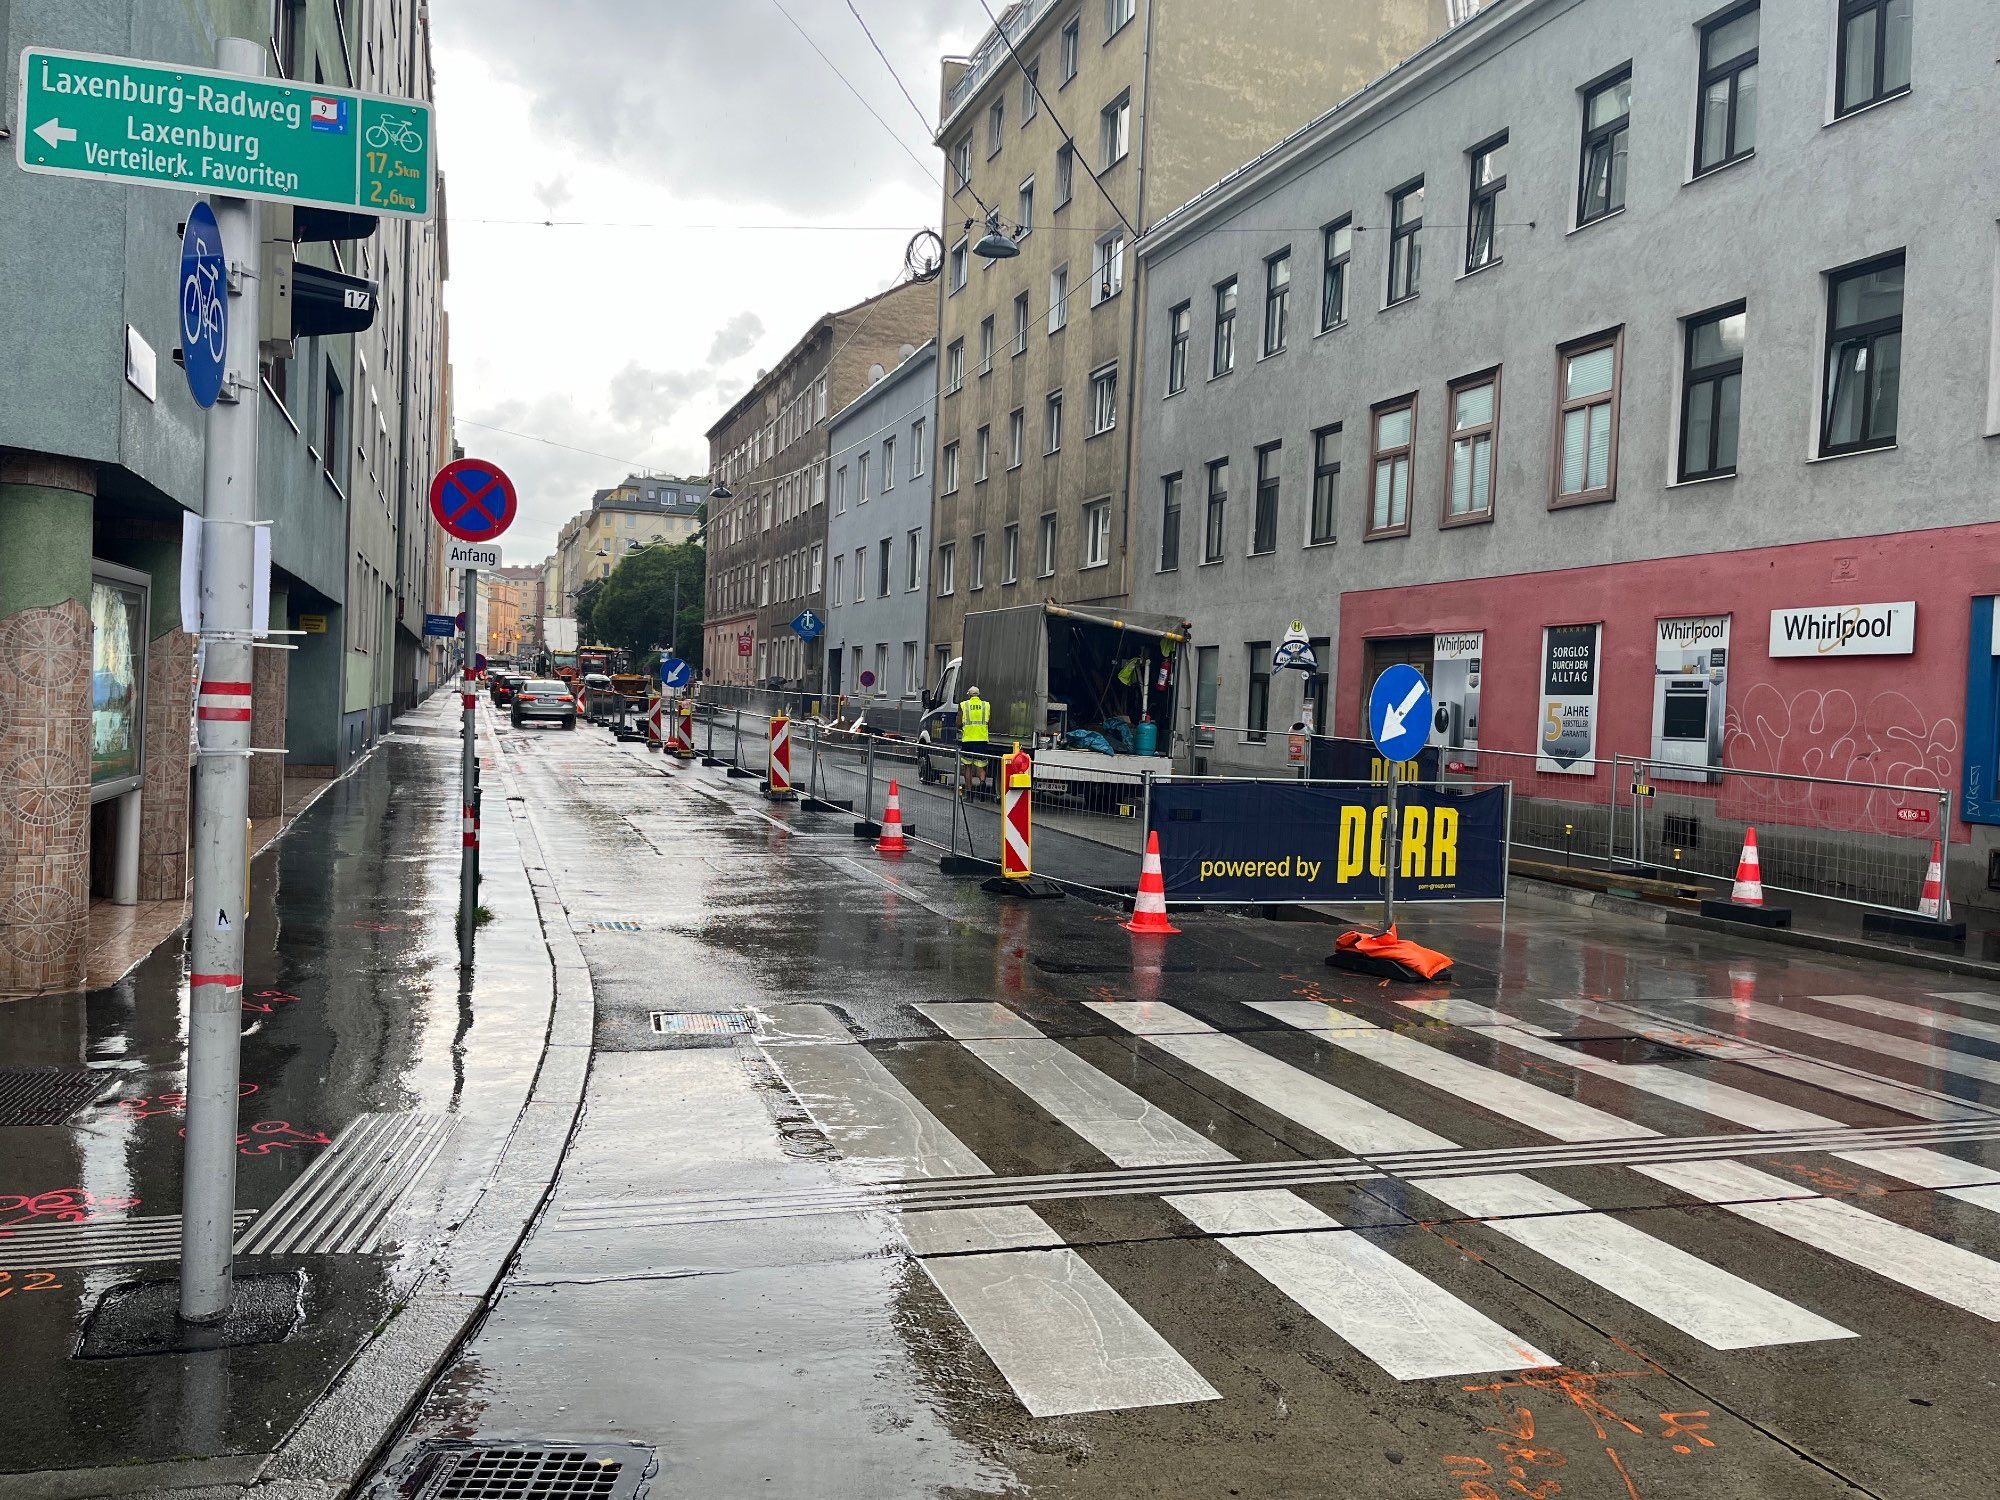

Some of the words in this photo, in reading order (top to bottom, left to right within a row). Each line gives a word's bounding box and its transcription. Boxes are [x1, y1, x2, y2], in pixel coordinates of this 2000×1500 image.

[42, 65, 300, 129] Laxenburg-Radweg
[321, 104, 327, 114] 9
[127, 115, 259, 160] Laxenburg
[85, 141, 194, 176] Verteilerk.
[201, 156, 298, 189] Favoriten
[347, 291, 369, 308] 17
[451, 547, 496, 566] Anfang
[1660, 619, 1723, 644] Whirlpool
[1784, 609, 1892, 646] Whirlpool
[1436, 635, 1479, 654] Whirlpool
[1552, 645, 1589, 658] SORGLOS
[1552, 660, 1574, 670] DURCH
[1574, 660, 1589, 670] DEN
[1551, 671, 1588, 682] ALLTAG
[1563, 705, 1589, 717] JAHRE
[1545, 703, 1562, 741] 5
[1562, 730, 1588, 738] GARANTIE
[1200, 856, 1290, 881] powered
[1297, 856, 1321, 882] by
